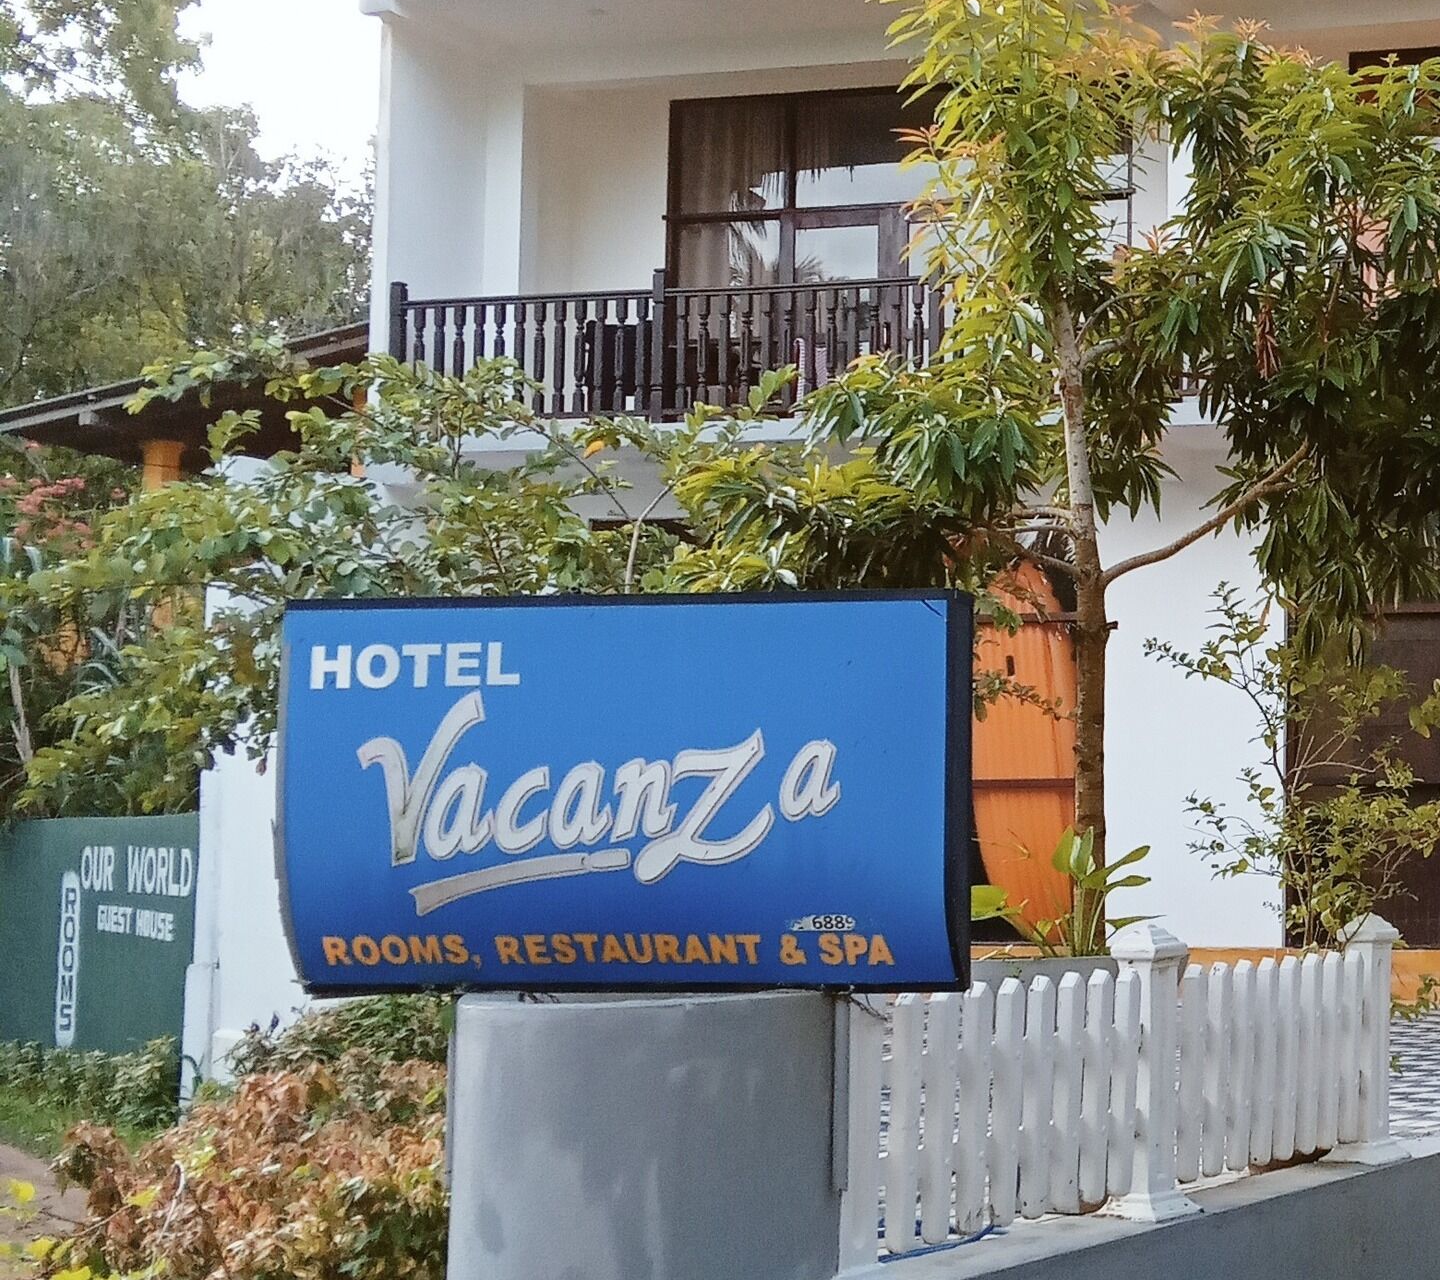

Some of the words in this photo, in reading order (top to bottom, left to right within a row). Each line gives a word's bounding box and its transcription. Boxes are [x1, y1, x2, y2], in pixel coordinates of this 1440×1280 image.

[310, 642, 520, 689] HOTEL
[81, 846, 115, 891] OUR
[127, 845, 192, 897] WORLD
[97, 905, 132, 934] GUEST
[135, 910, 175, 942] HOUSE
[59, 887, 76, 1031] ROOMS
[322, 934, 482, 969] ROOMS,
[494, 933, 760, 964] RESTAURANT
[780, 934, 806, 965] &
[818, 933, 895, 965] SPA
